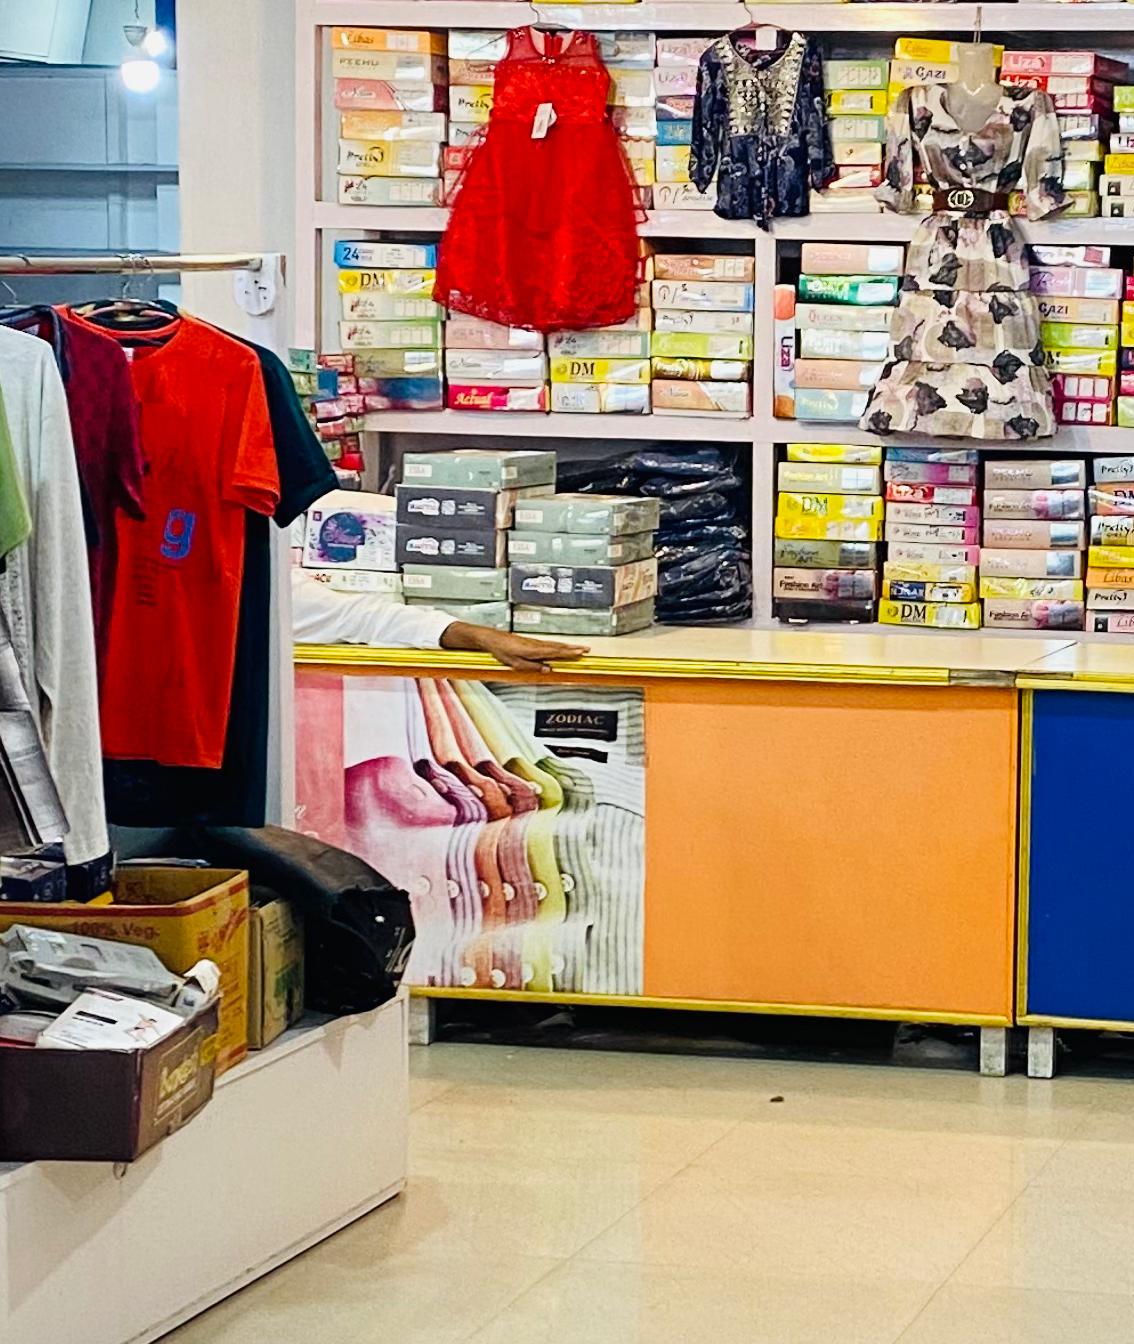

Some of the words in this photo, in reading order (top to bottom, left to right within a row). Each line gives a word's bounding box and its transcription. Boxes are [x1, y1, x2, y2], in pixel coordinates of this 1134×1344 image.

[915, 67, 946, 80] GAZI
[342, 247, 361, 261] 24
[1038, 303, 1069, 317] GAZI
[570, 361, 595, 376] DM
[901, 604, 927, 621] DM
[545, 713, 605, 725] ZODIAC
